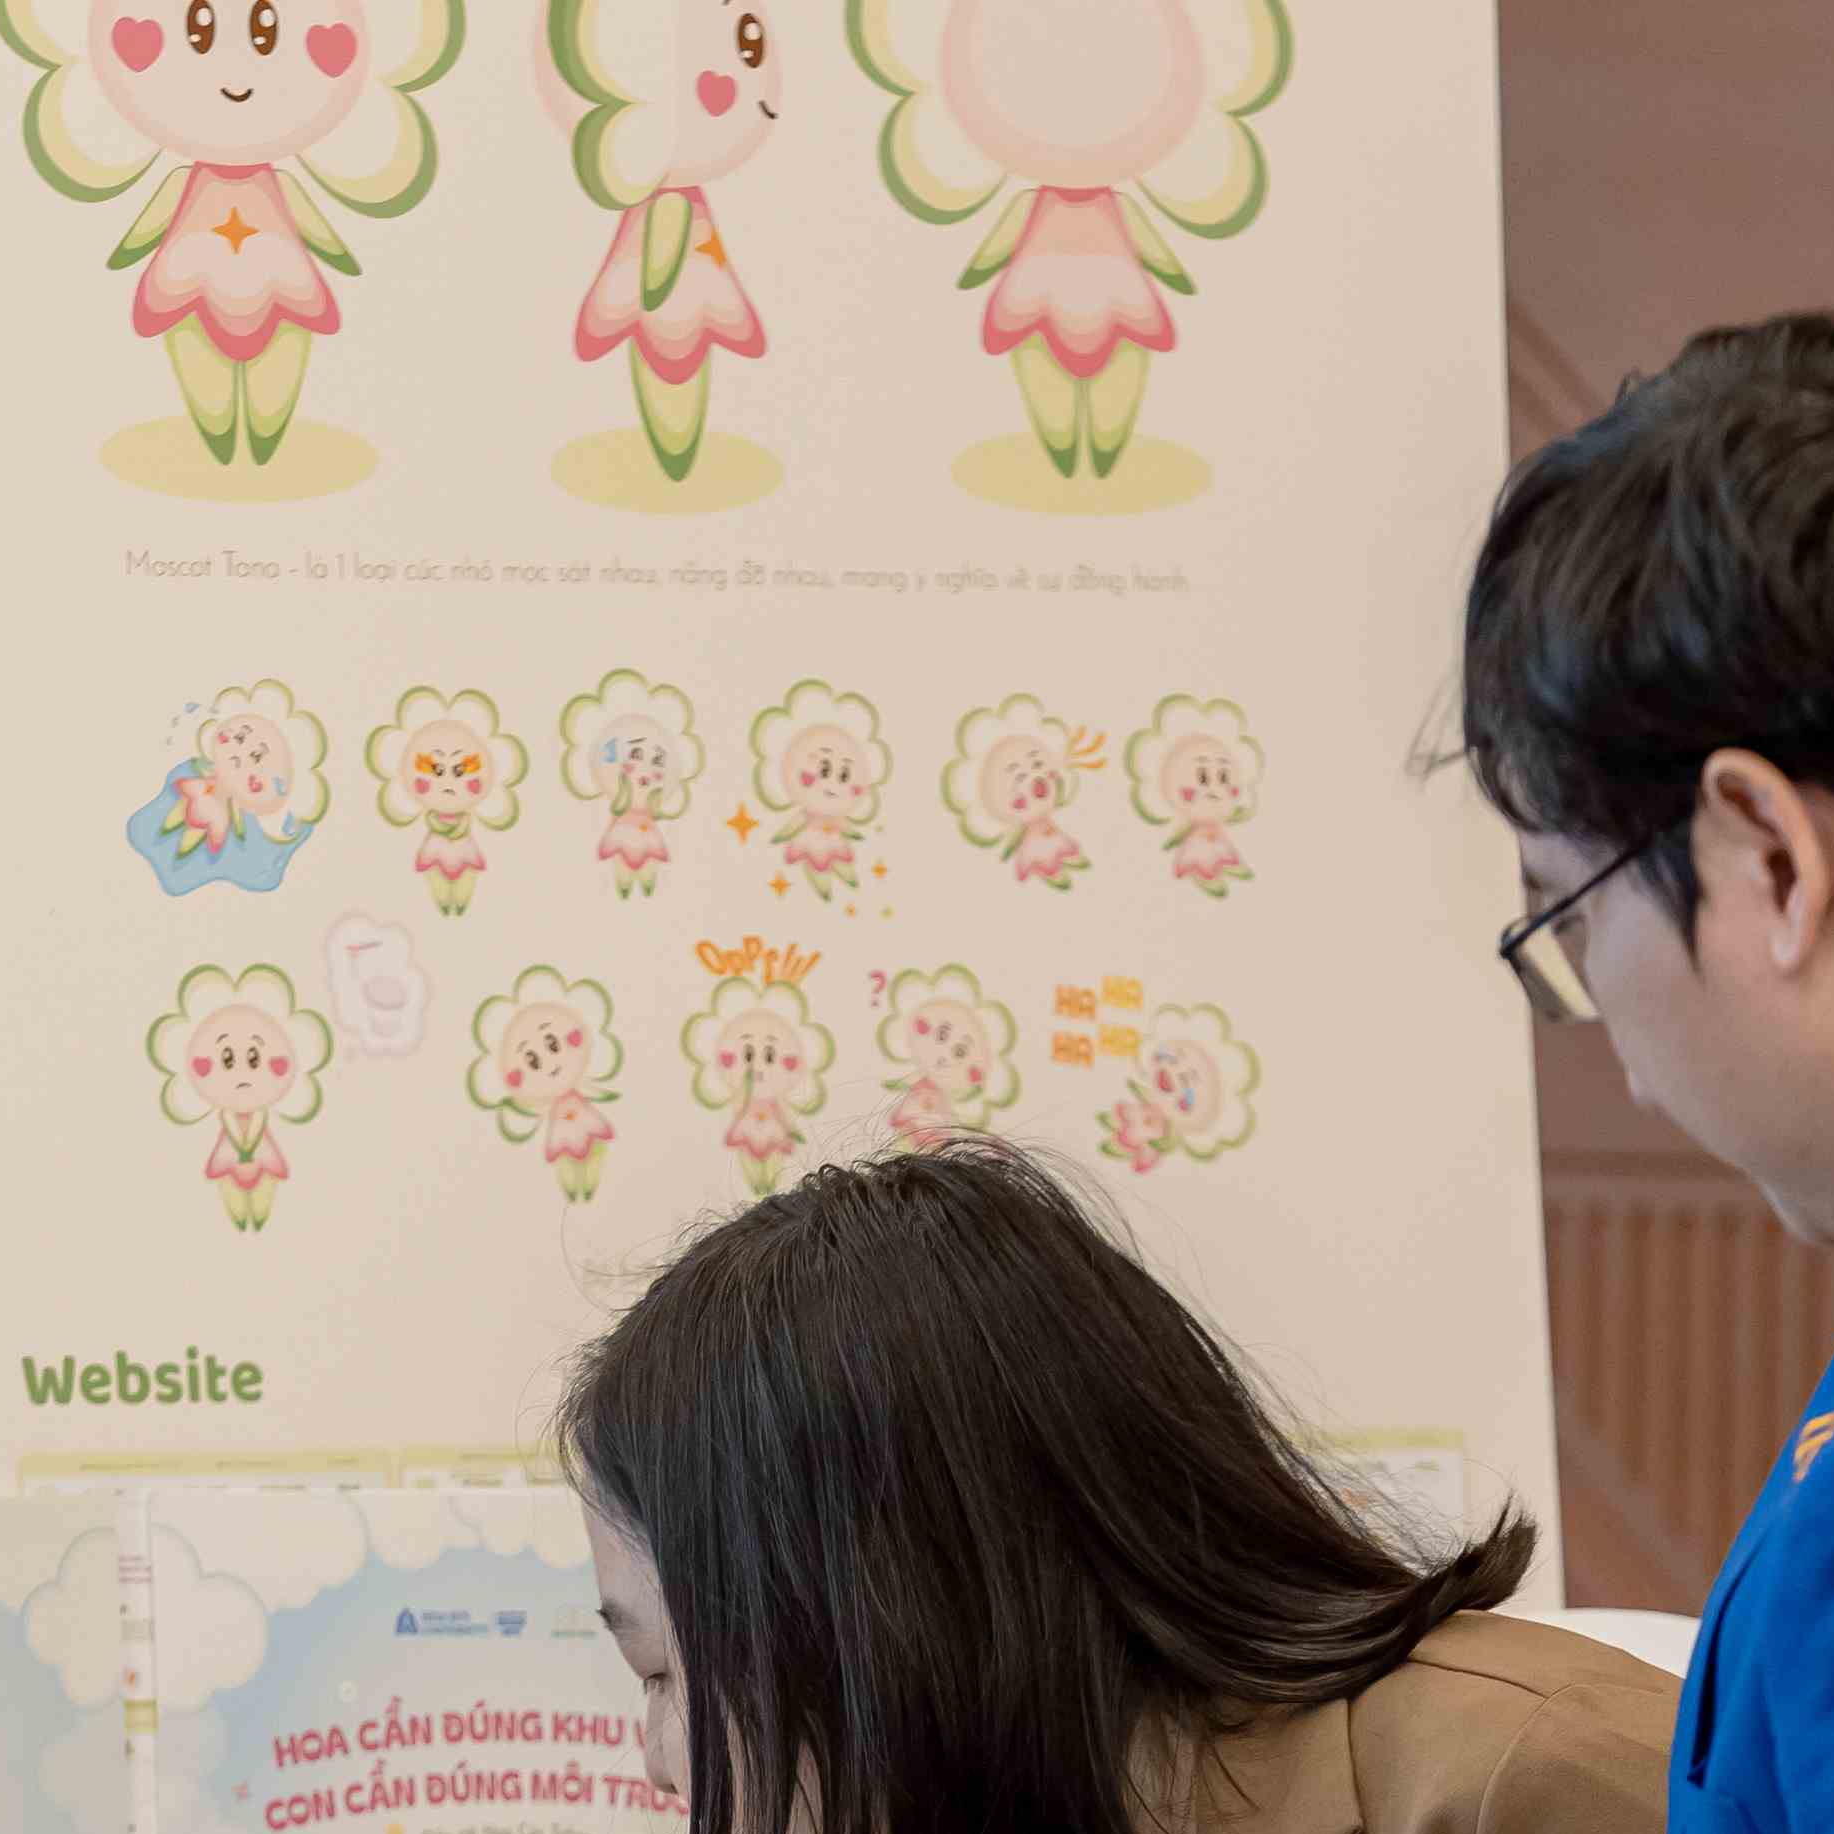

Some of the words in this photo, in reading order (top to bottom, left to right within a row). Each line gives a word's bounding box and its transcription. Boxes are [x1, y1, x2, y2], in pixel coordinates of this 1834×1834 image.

[21, 1345, 264, 1406] Website
[272, 1725, 350, 1769] HOA
[358, 1696, 433, 1752] CẦN
[442, 1700, 543, 1745] ĐÚNG
[551, 1711, 626, 1748] KHU
[264, 1789, 337, 1832] CON
[343, 1758, 417, 1816] CẦN
[425, 1761, 523, 1805] ĐÚNG
[530, 1760, 594, 1805] MÔI
